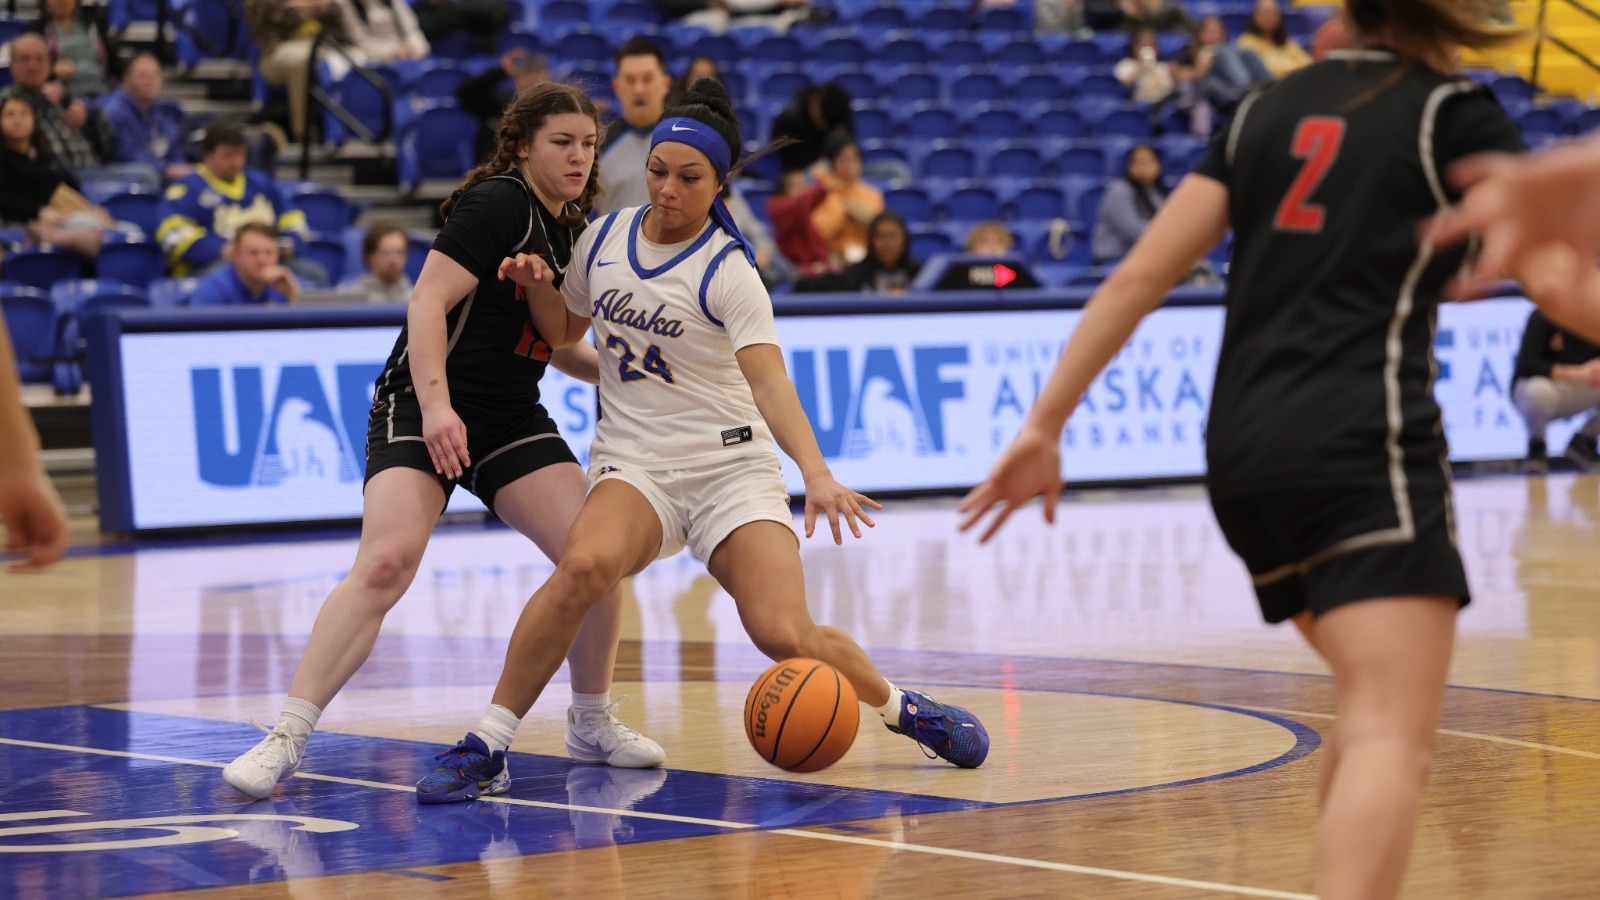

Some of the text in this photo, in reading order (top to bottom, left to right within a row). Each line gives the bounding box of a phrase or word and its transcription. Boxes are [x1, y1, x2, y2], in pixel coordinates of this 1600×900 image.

[1274, 115, 1346, 232] 2
[592, 288, 685, 338] Alaska
[604, 332, 678, 387] 24
[983, 334, 1204, 367] UNIVTY OF
[792, 345, 969, 460] UAF
[990, 365, 1206, 418] ASKA
[989, 419, 1206, 452] FRBANK
[755, 666, 803, 739] Wilson
